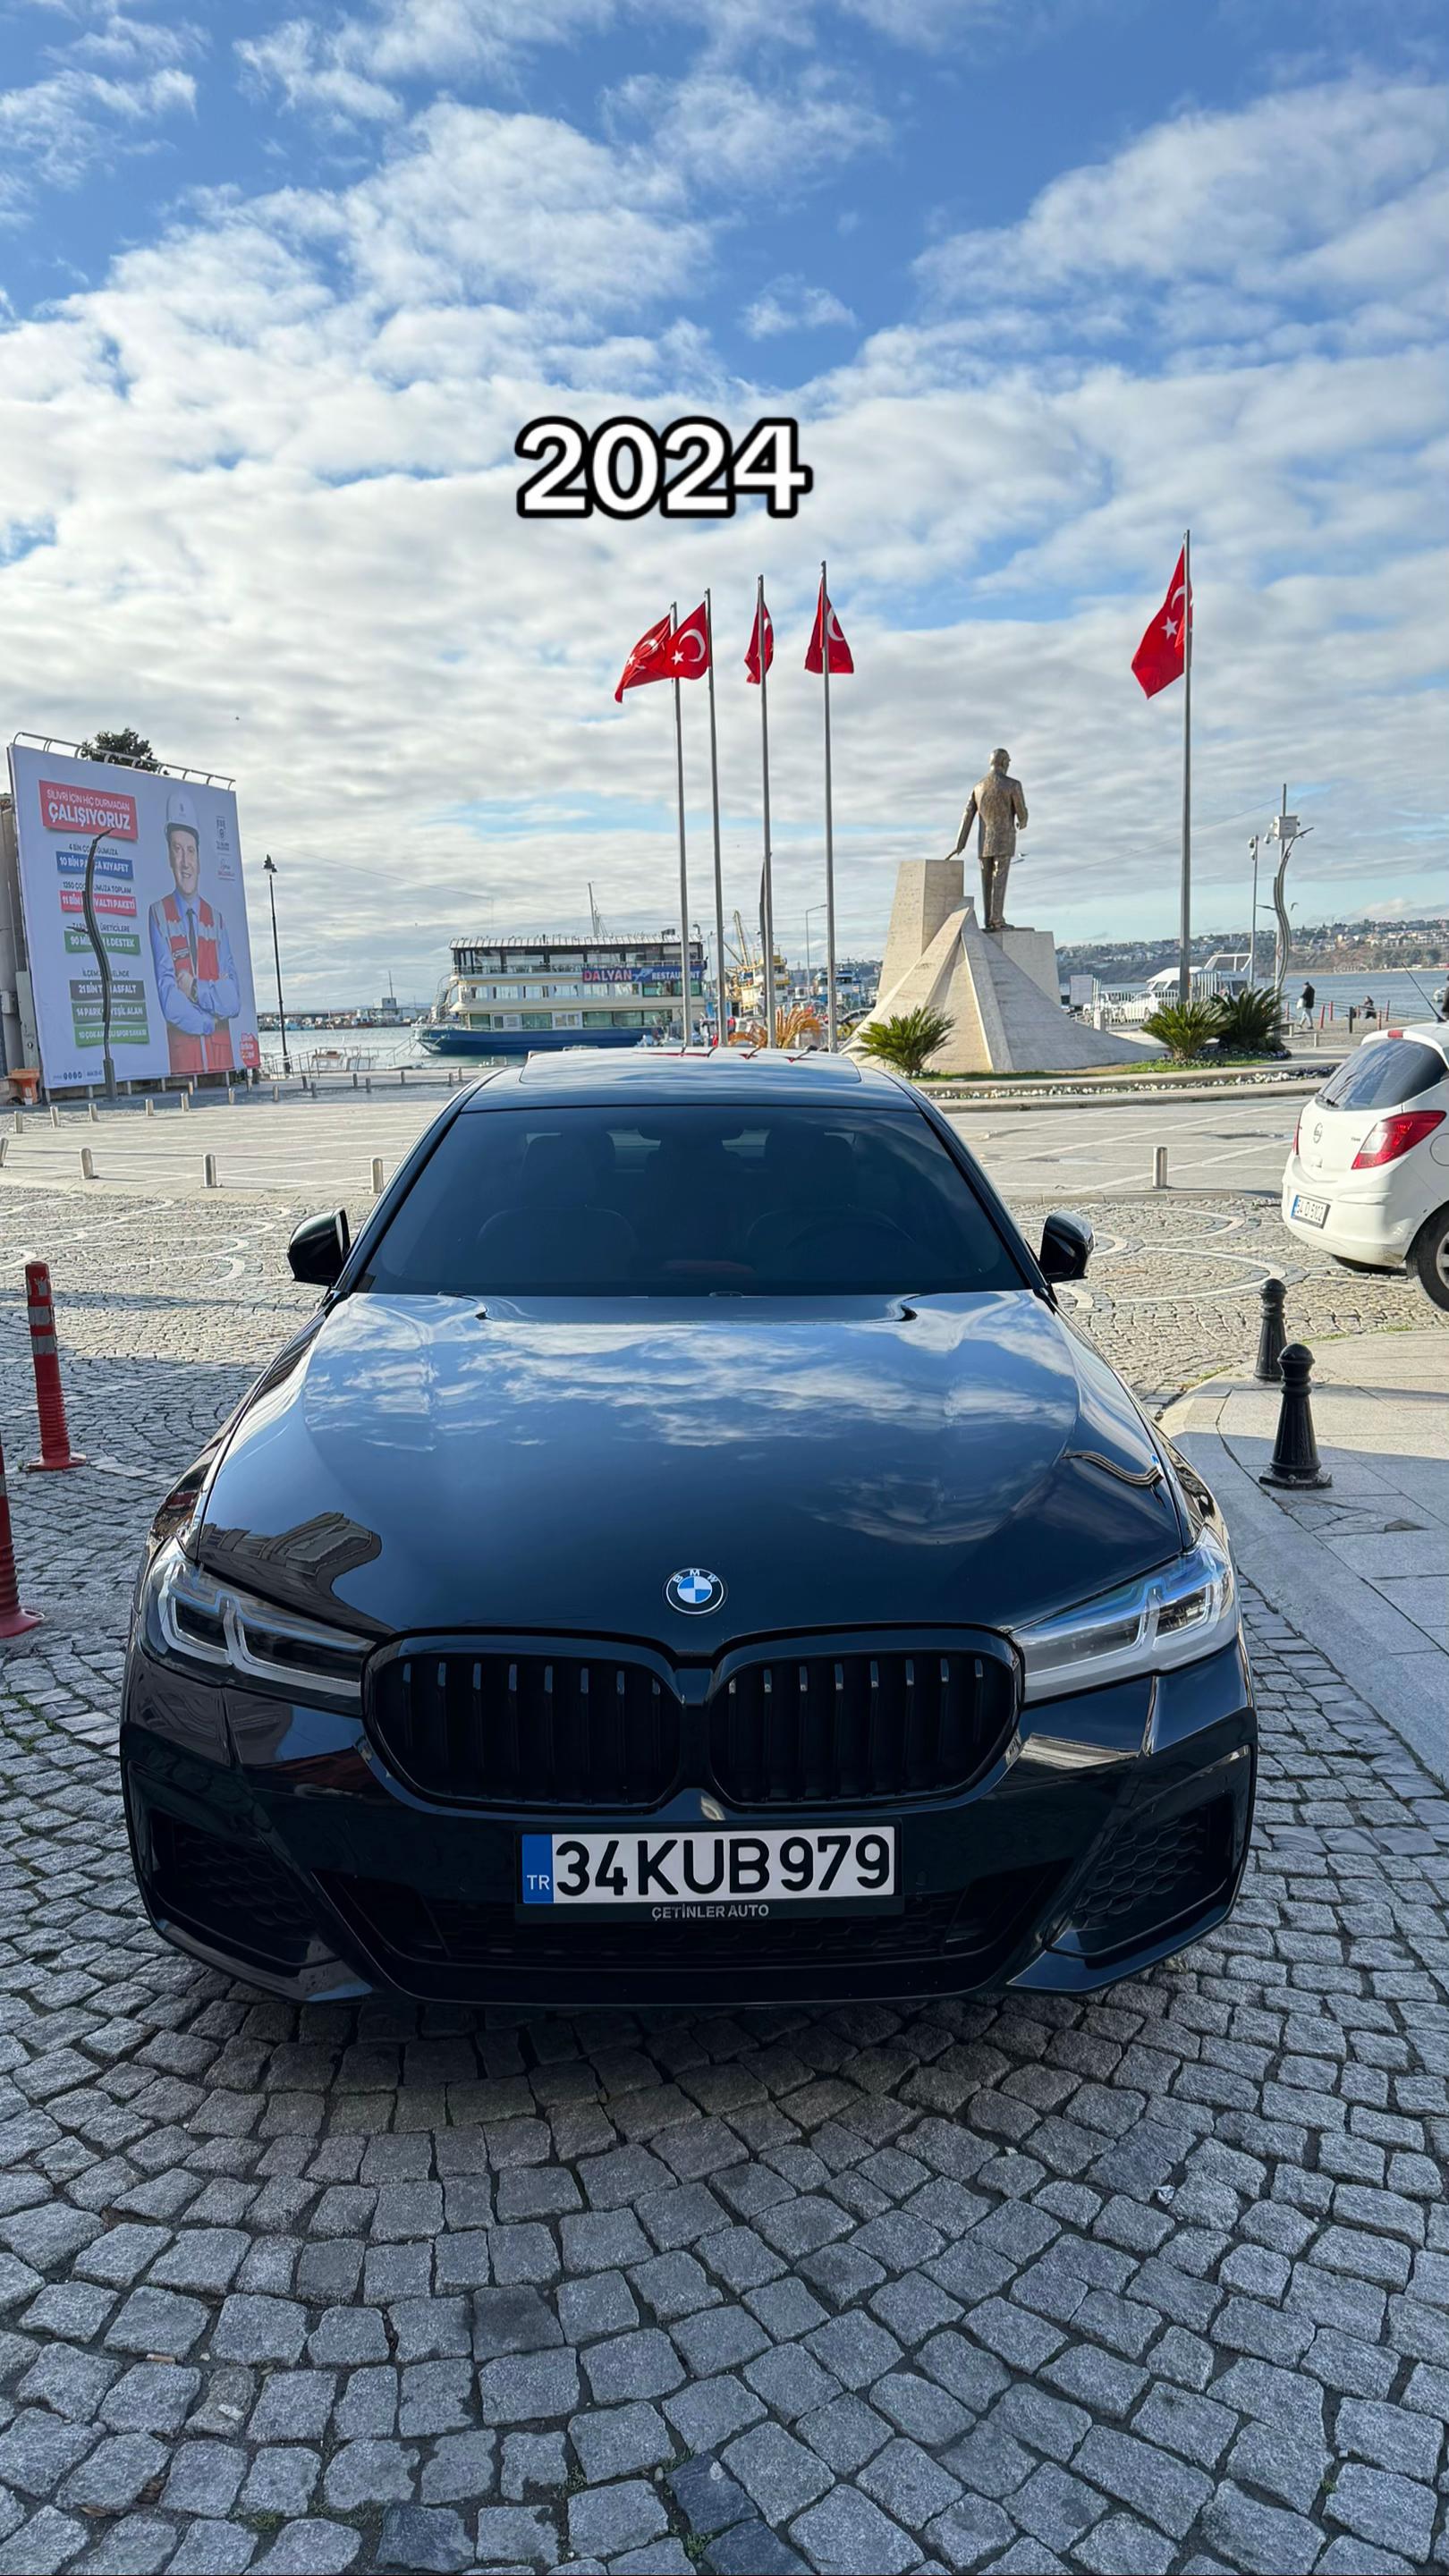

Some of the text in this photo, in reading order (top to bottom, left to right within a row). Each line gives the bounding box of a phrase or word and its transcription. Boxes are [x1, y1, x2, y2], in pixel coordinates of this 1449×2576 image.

[47, 789, 68, 802] SİLİVRİ
[83, 795, 94, 807] HİÇ
[95, 798, 130, 810] DURMADAN
[48, 802, 131, 830] ÇALIŞIYORUZ
[102, 861, 129, 873] KIYAFET
[584, 970, 631, 981] DALYAN
[113, 985, 136, 993] ASFALT
[673, 1569, 718, 1583] BMW
[555, 1835, 890, 1896] 34 KUB 979
[527, 1875, 550, 1891] TR
[652, 1903, 769, 1921] ÇETİNLER AUTO
